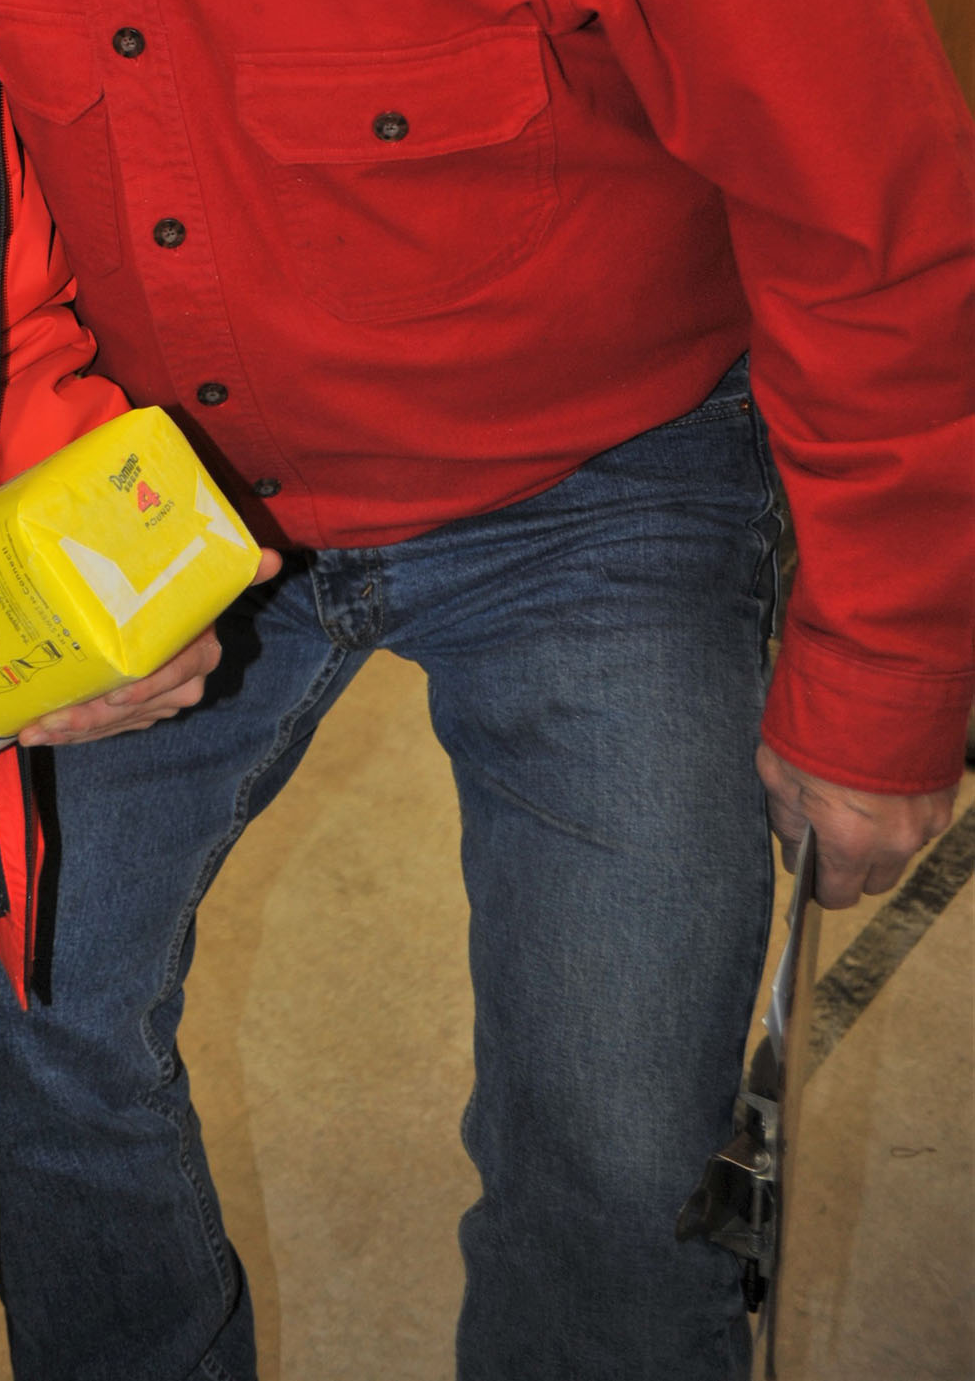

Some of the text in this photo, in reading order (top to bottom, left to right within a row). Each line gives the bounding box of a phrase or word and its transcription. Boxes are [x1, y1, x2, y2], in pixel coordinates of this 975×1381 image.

[109, 453, 139, 492] Domino
[136, 480, 161, 513] 4
[145, 500, 174, 530] POUNDS
